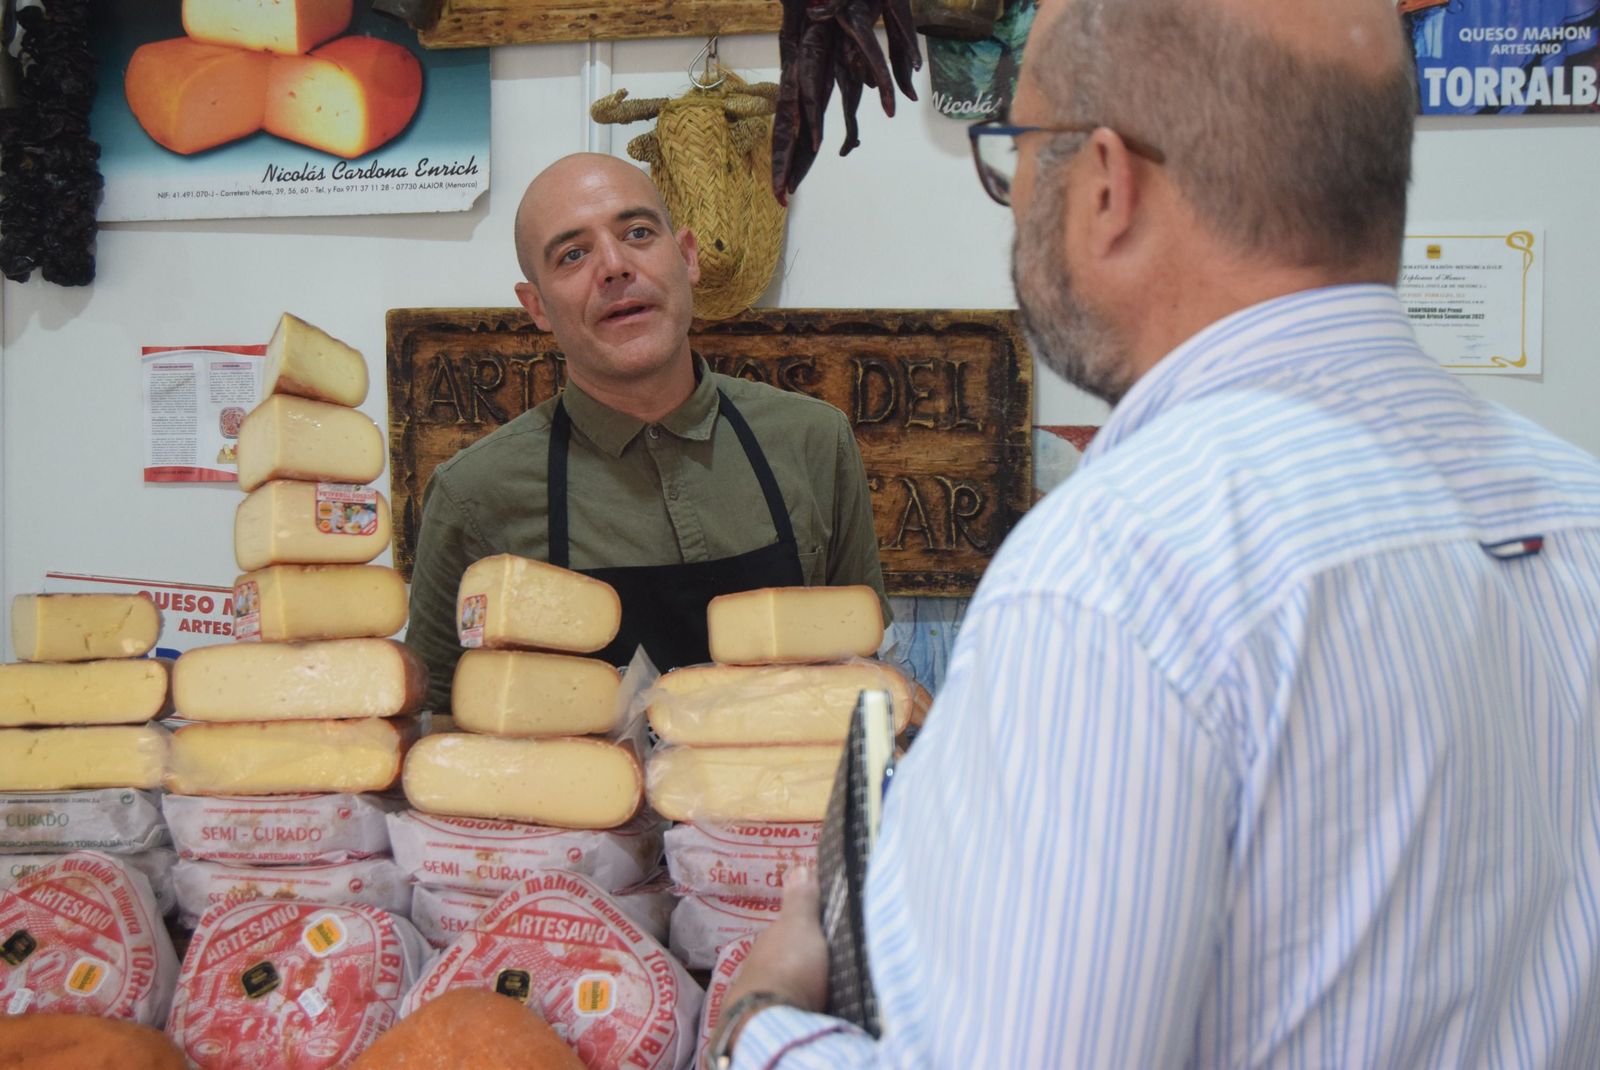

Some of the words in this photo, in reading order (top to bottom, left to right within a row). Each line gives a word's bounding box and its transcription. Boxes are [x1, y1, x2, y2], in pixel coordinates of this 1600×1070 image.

[1459, 27, 1518, 42] QUESO
[1523, 26, 1591, 40] MAHON
[1491, 42, 1561, 55] ARTESANO
[1424, 66, 1600, 107] TORRALB
[262, 161, 326, 184] Nicolás
[332, 160, 408, 181] Cardona
[415, 156, 479, 177] Enrich
[220, 189, 249, 198] Carretera
[300, 186, 308, 194] 60
[333, 185, 344, 193] Fax
[346, 184, 358, 192] 971
[360, 184, 368, 192] 37
[381, 183, 389, 191] 28
[396, 182, 417, 191] 07730
[419, 182, 444, 190] ALAIOR
[445, 181, 478, 190] (Menorca)
[853, 357, 983, 430] DEL
[179, 619, 235, 636] ARTES
[6, 813, 69, 827] CURADO
[201, 827, 237, 841] SEMI
[253, 827, 322, 841] CURADO
[423, 860, 460, 877] SEMI
[709, 868, 747, 886] SEMI
[524, 874, 588, 899] mahón
[29, 885, 115, 931] ARTESANO
[205, 903, 300, 965] ARTESANO
[508, 914, 610, 945] ARTESANO
